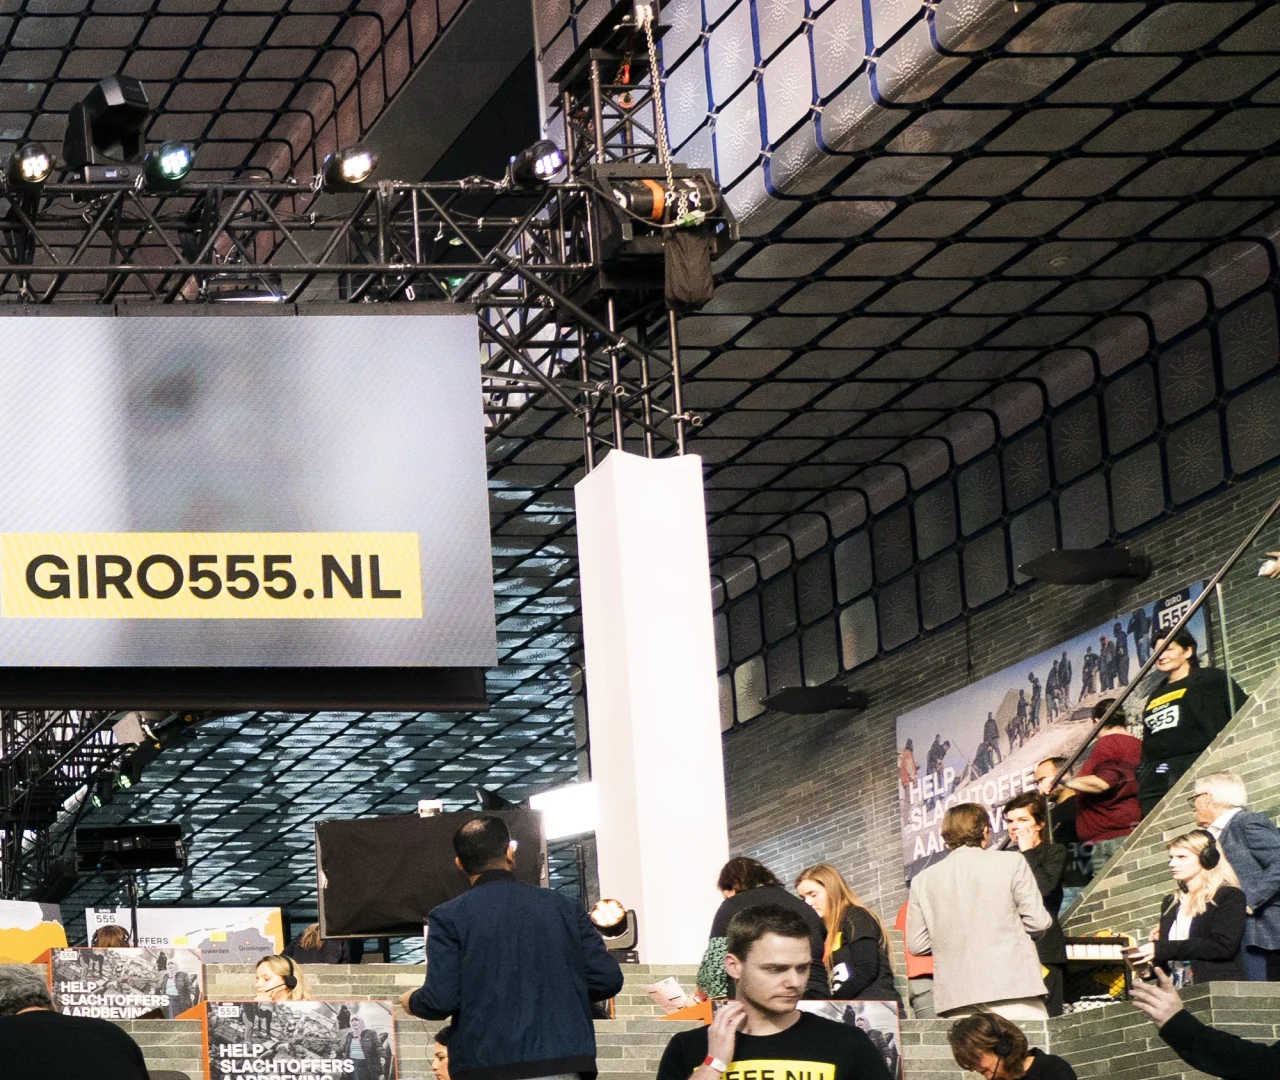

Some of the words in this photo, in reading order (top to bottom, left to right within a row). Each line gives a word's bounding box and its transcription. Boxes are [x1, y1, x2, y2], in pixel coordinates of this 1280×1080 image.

[25, 554, 401, 600] GIRO555.NL
[909, 766, 955, 805] HELP
[96, 915, 116, 923] 555
[238, 944, 270, 952] Groningen
[61, 981, 97, 993] HELP
[61, 994, 170, 1006] SLACHTOFFERS
[220, 1043, 264, 1057] HELP
[220, 1059, 355, 1073] SLACHTOFFERS
